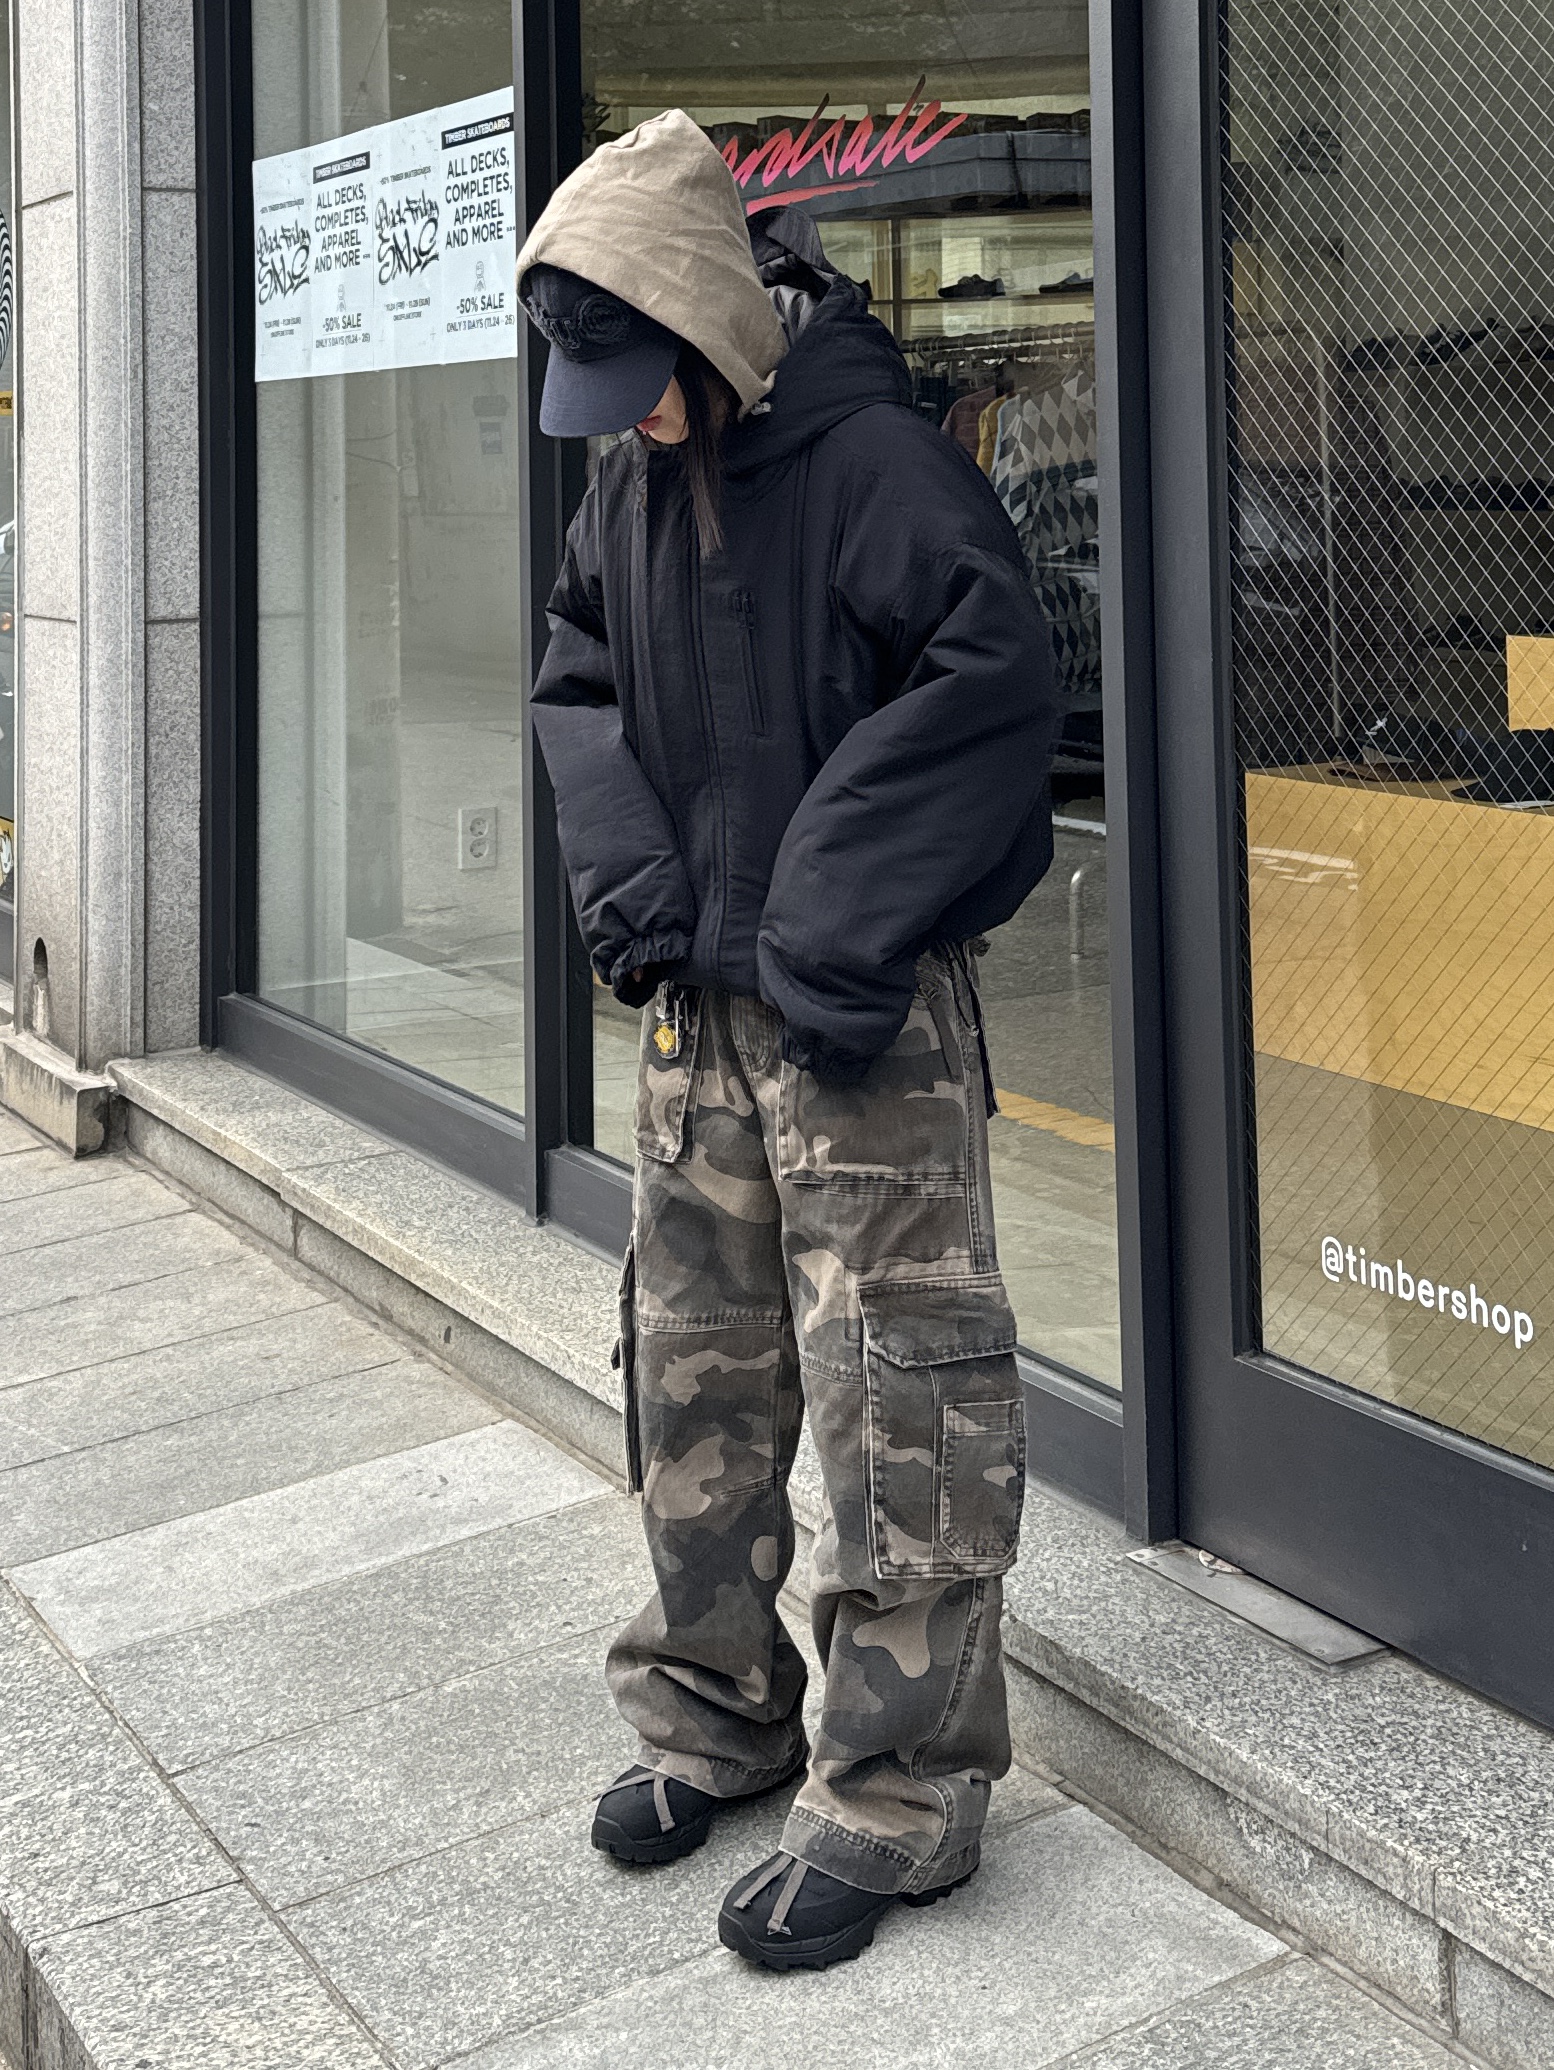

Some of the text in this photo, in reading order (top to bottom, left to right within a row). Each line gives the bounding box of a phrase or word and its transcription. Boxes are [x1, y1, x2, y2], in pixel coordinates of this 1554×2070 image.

[467, 116, 511, 139] SKATEBOARDS
[447, 146, 510, 180] ALL DECKS,
[316, 190, 333, 211] ALL
[334, 182, 367, 206] DECKS,
[444, 171, 513, 204] COMPLETES,
[314, 204, 369, 233] COMPLETES,
[453, 198, 505, 227] APPAREL
[320, 228, 362, 253] APPAREL
[444, 227, 469, 250] AND
[471, 219, 503, 246] MORE
[313, 254, 333, 274] AND
[334, 248, 361, 268] MORE
[456, 292, 505, 315] -50% SALE
[322, 315, 341, 333] -50%
[341, 312, 362, 330] SALE
[446, 321, 462, 333] ONLY
[467, 317, 484, 331] DAYS
[1321, 1235, 1535, 1350] @timbershop
